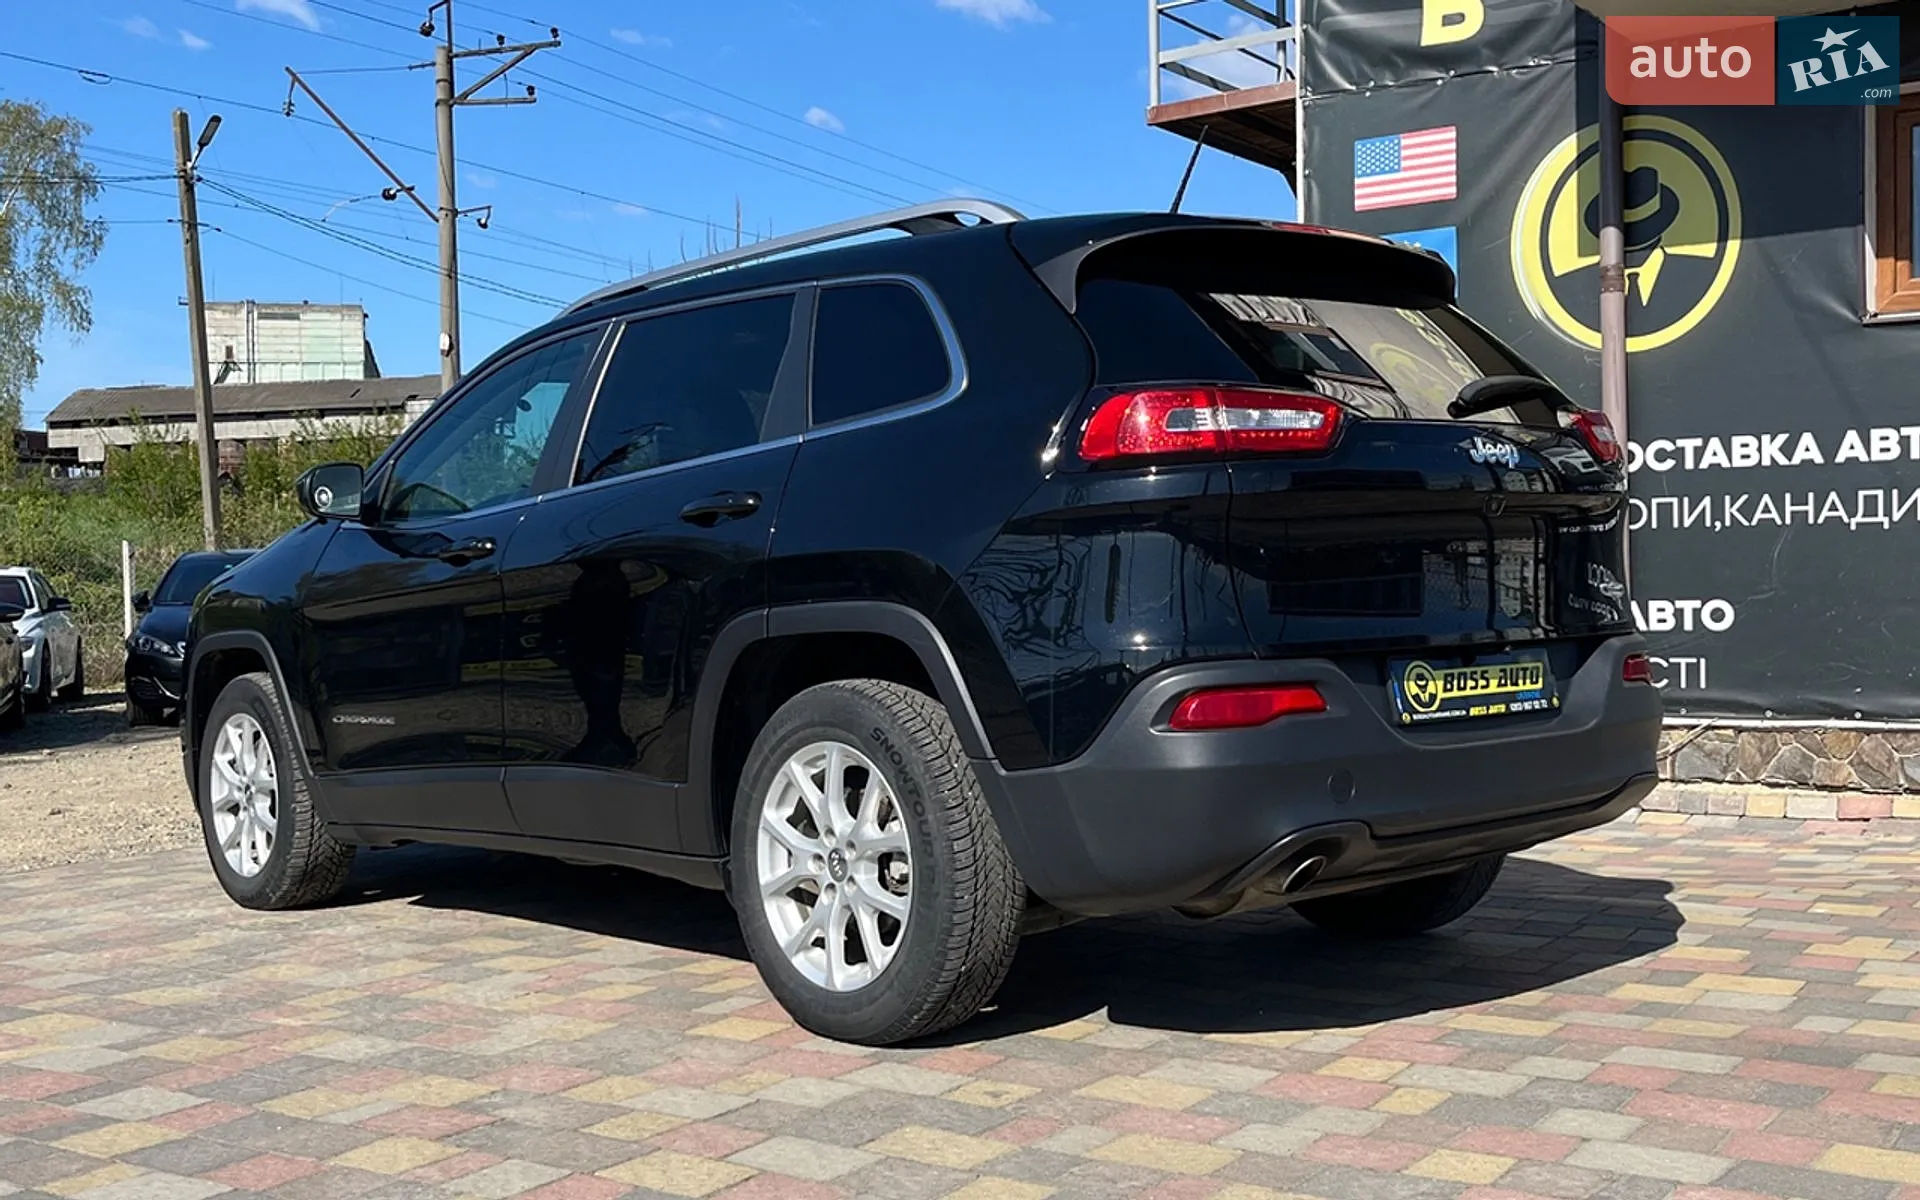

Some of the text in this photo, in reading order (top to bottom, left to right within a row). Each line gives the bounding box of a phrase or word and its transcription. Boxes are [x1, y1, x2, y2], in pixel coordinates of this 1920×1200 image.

[1469, 436, 1519, 469] Jeep
[1443, 665, 1540, 693] BOSS AUTO
